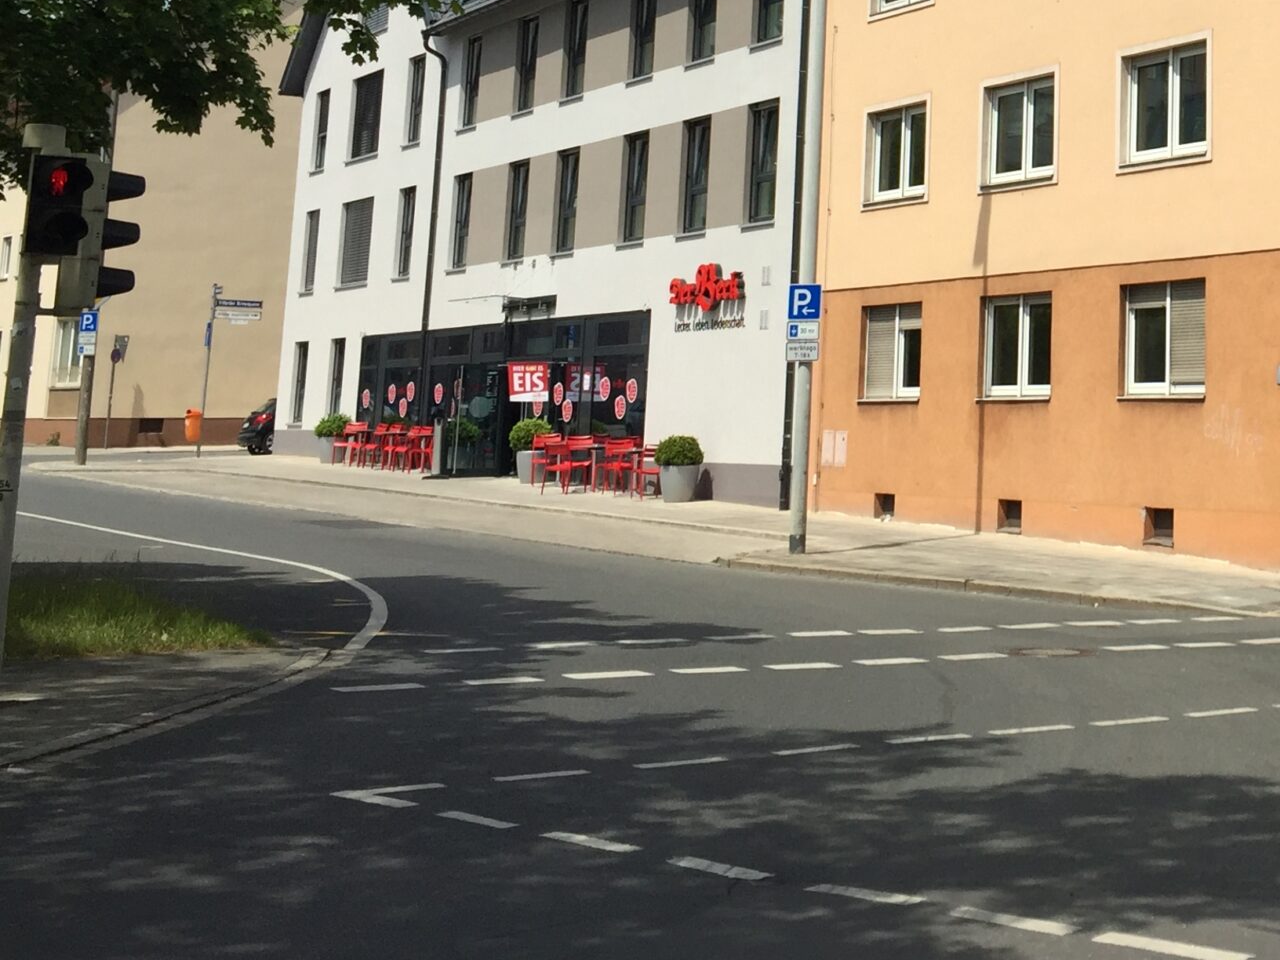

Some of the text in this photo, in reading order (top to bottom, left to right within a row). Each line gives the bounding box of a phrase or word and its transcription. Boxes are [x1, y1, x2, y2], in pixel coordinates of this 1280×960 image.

[793, 288, 812, 316] P
[82, 314, 94, 330] P
[513, 372, 545, 392] EIS
